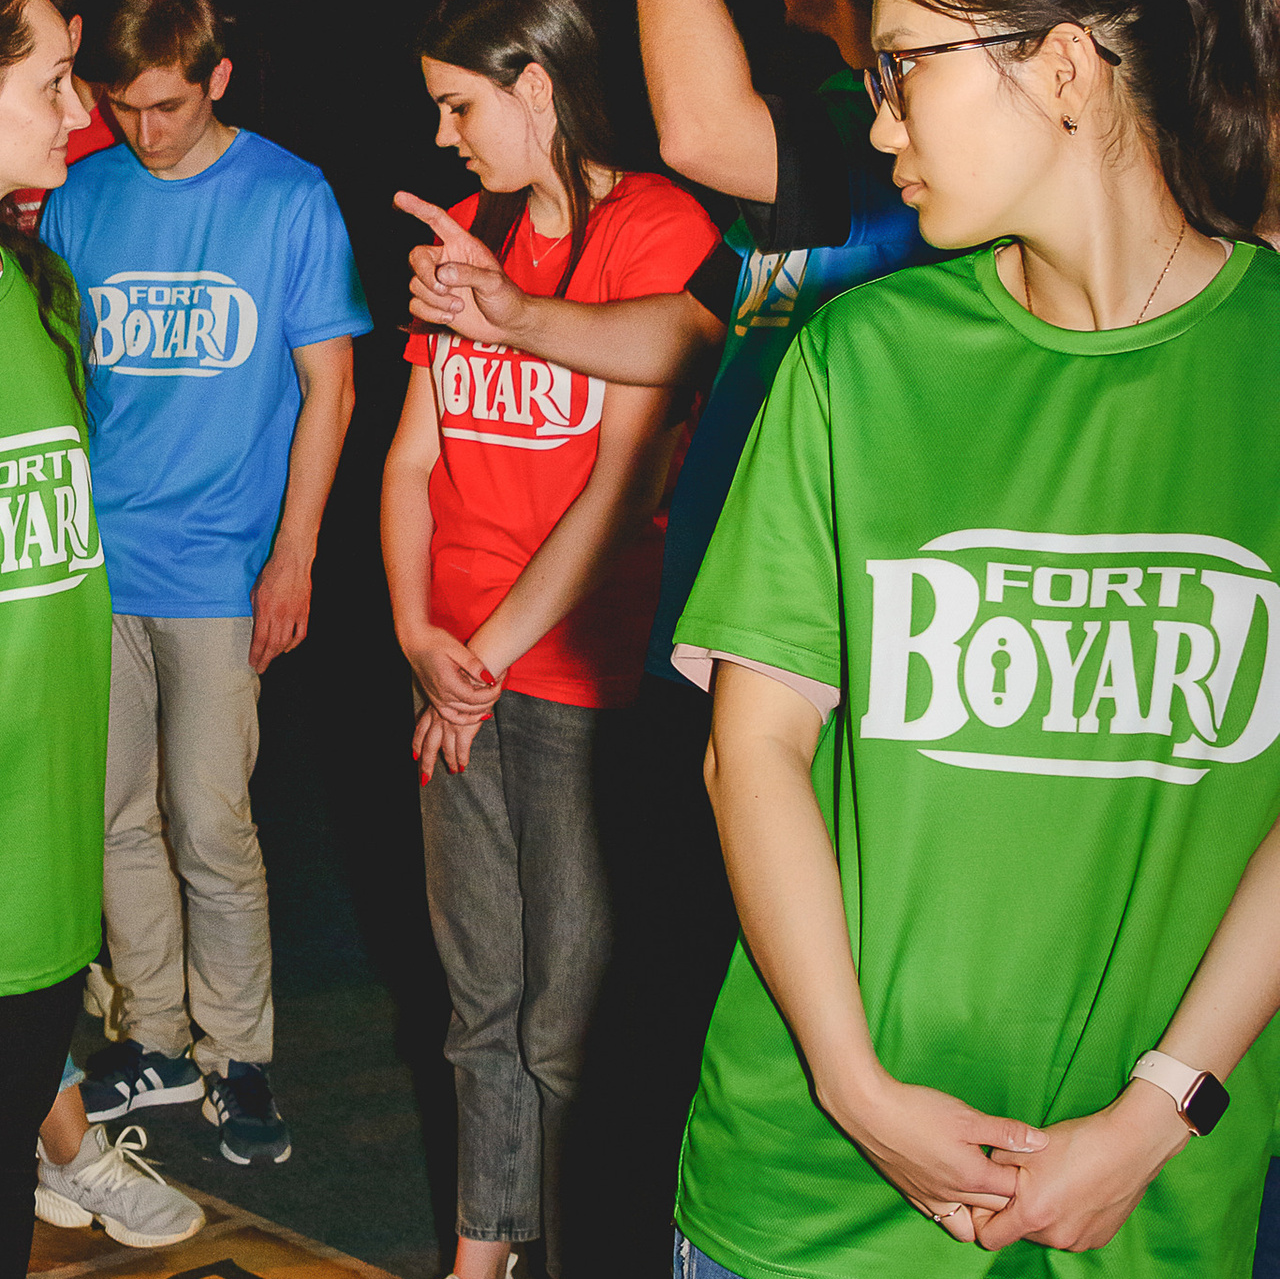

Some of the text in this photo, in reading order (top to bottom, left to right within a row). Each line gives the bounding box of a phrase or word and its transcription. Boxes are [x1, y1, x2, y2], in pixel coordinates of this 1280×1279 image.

[88, 286, 258, 368] BOYARD
[129, 286, 206, 306] FORT
[984, 562, 1197, 609] FORT
[860, 557, 1280, 764] BOYARD
